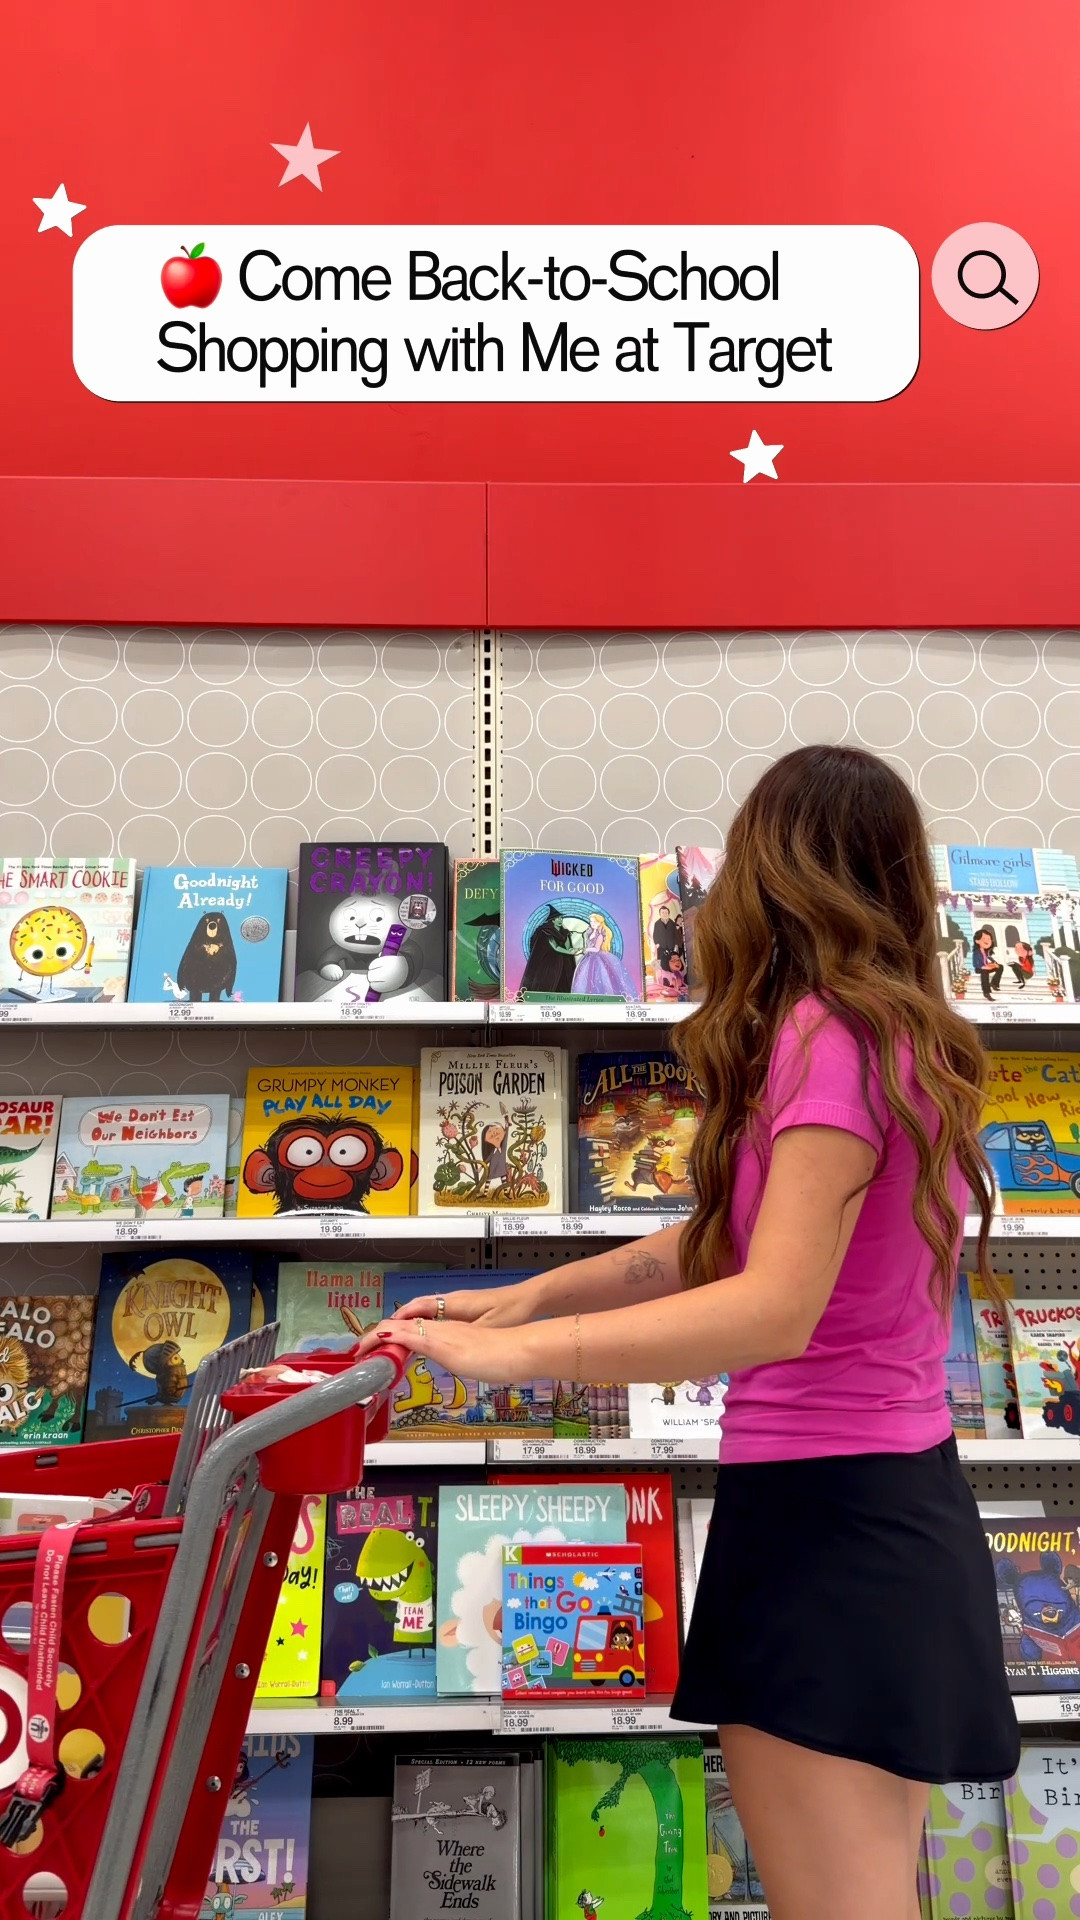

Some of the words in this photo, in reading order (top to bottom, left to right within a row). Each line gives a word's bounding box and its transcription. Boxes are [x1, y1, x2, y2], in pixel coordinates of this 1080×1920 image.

[311, 847, 433, 869] CREEPY
[951, 849, 1000, 866] Gilmore
[1002, 852, 1032, 874] girls
[551, 859, 593, 878] WICKED
[20, 870, 68, 889] SMART
[71, 870, 129, 889] COOKIE
[173, 872, 260, 891] Goodnight
[310, 872, 433, 894] CRAYON!
[540, 879, 564, 892] FOR
[567, 881, 605, 895] GOOD
[177, 892, 252, 910] Already!
[464, 887, 499, 900] DEFY
[341, 1008, 362, 1016] 18.99
[626, 1010, 647, 1018] 18.99
[448, 1060, 491, 1069] MILLIE
[495, 1059, 538, 1069] FLEUR'S
[257, 1078, 327, 1093] GRUMPY
[331, 1077, 400, 1093] MONKEY
[439, 1071, 483, 1097] POISON
[492, 1070, 546, 1096] GARDEN
[583, 1064, 633, 1105] ALL
[631, 1063, 647, 1075] THE
[262, 1095, 308, 1117] PLAY
[311, 1093, 343, 1109] ALL
[348, 1095, 392, 1115] DAY
[1024, 1092, 1060, 1109] New
[0, 1114, 54, 1135] AR!
[98, 1110, 122, 1124] We
[128, 1108, 167, 1122] Don't
[172, 1108, 195, 1122] Eat
[91, 1127, 117, 1141] Our
[122, 1125, 198, 1141] Neighbors
[589, 1204, 612, 1214] Hayley
[613, 1204, 632, 1212] Rocco
[116, 1227, 138, 1235] 18.99
[320, 1225, 342, 1233] 19.99
[503, 1223, 525, 1231] 18.99
[561, 1222, 583, 1231] 18.99
[1002, 1223, 1024, 1231] 19.99
[306, 1270, 355, 1288] llama
[360, 1270, 382, 1288] lla
[123, 1280, 222, 1318] KNIGHT
[328, 1291, 371, 1308] little
[143, 1311, 198, 1342] OWL
[662, 1418, 699, 1426] WILLIAM
[522, 1446, 545, 1454] 17.99
[574, 1446, 597, 1454] 18.99
[651, 1446, 674, 1454] 17.99
[346, 1486, 376, 1499] THE
[340, 1500, 411, 1530] REAL
[417, 1496, 436, 1528] T.
[455, 1494, 527, 1522] SLEEPY
[535, 1495, 612, 1523] SHEEPY
[626, 1486, 664, 1525] NK
[46, 1549, 55, 1562] Do
[505, 1545, 518, 1562] K
[42, 1565, 51, 1580] not
[52, 1554, 64, 1586] Please
[283, 1566, 319, 1589] ay!
[509, 1572, 565, 1593] Things
[40, 1582, 49, 1609] Leave
[49, 1588, 60, 1619] Fasten
[525, 1596, 552, 1609] that
[556, 1590, 593, 1614] Go
[404, 1606, 424, 1615] TEAM
[39, 1612, 48, 1635] Child
[402, 1616, 424, 1630] ME
[514, 1612, 568, 1634] Bingo
[48, 1621, 58, 1645] Child
[35, 1638, 46, 1690] Unattended
[44, 1647, 54, 1688] Securely
[1027, 1665, 1040, 1676] T.
[1040, 1665, 1080, 1676] HIGGINS
[333, 1717, 353, 1726] 8.99
[504, 1718, 528, 1727] 18.99
[612, 1716, 636, 1725] 18.99
[704, 1755, 726, 1772] HER
[230, 1820, 260, 1836] THE
[659, 1823, 682, 1837] Giving
[436, 1839, 485, 1857] Where
[663, 1840, 678, 1853] Tree
[449, 1857, 472, 1875] the
[423, 1870, 497, 1893] Sidewalk
[440, 1891, 480, 1909] Ends
